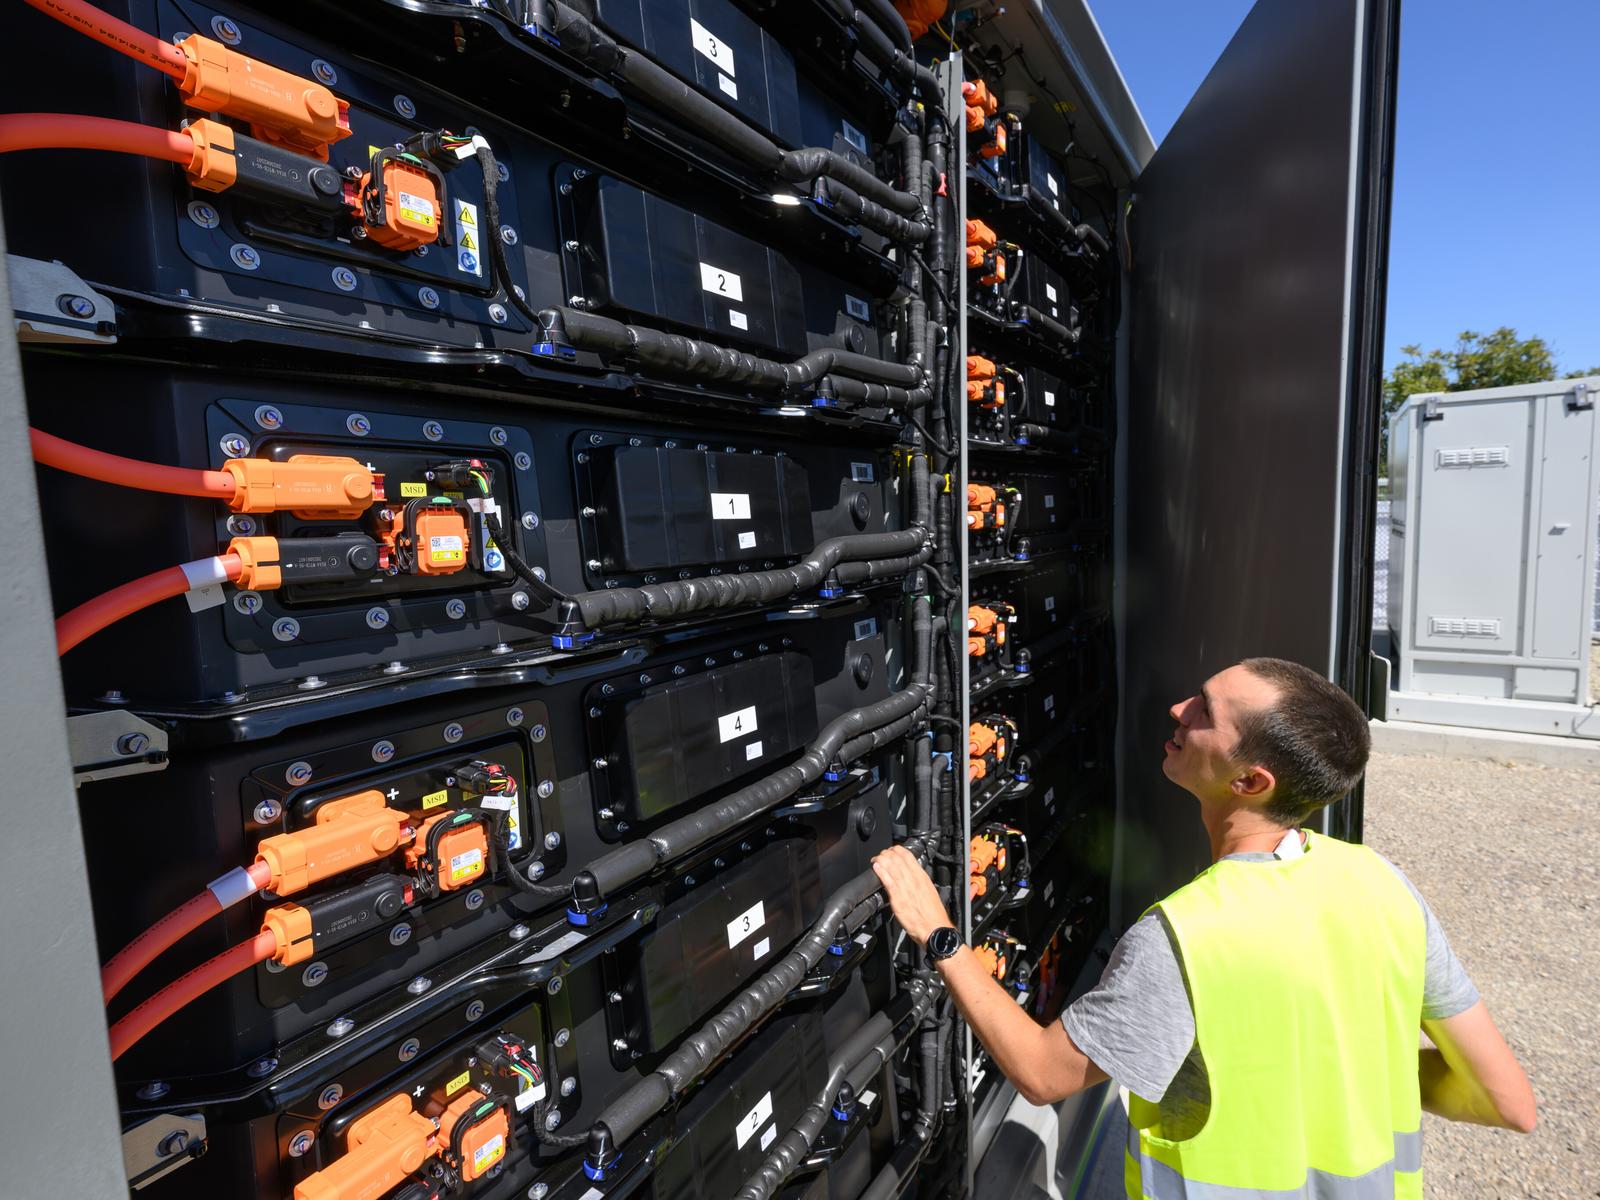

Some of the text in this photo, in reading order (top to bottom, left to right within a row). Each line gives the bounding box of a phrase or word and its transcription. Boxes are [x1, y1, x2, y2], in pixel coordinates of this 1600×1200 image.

[708, 37, 718, 58] 3
[717, 273, 727, 292] 2
[404, 485, 425, 495] MSD
[728, 498, 736, 515] 1
[733, 715, 743, 732] 4
[426, 793, 446, 805] MSD
[742, 915, 751, 933] 3
[449, 1074, 468, 1091] MSD
[750, 1111, 760, 1130] 2
